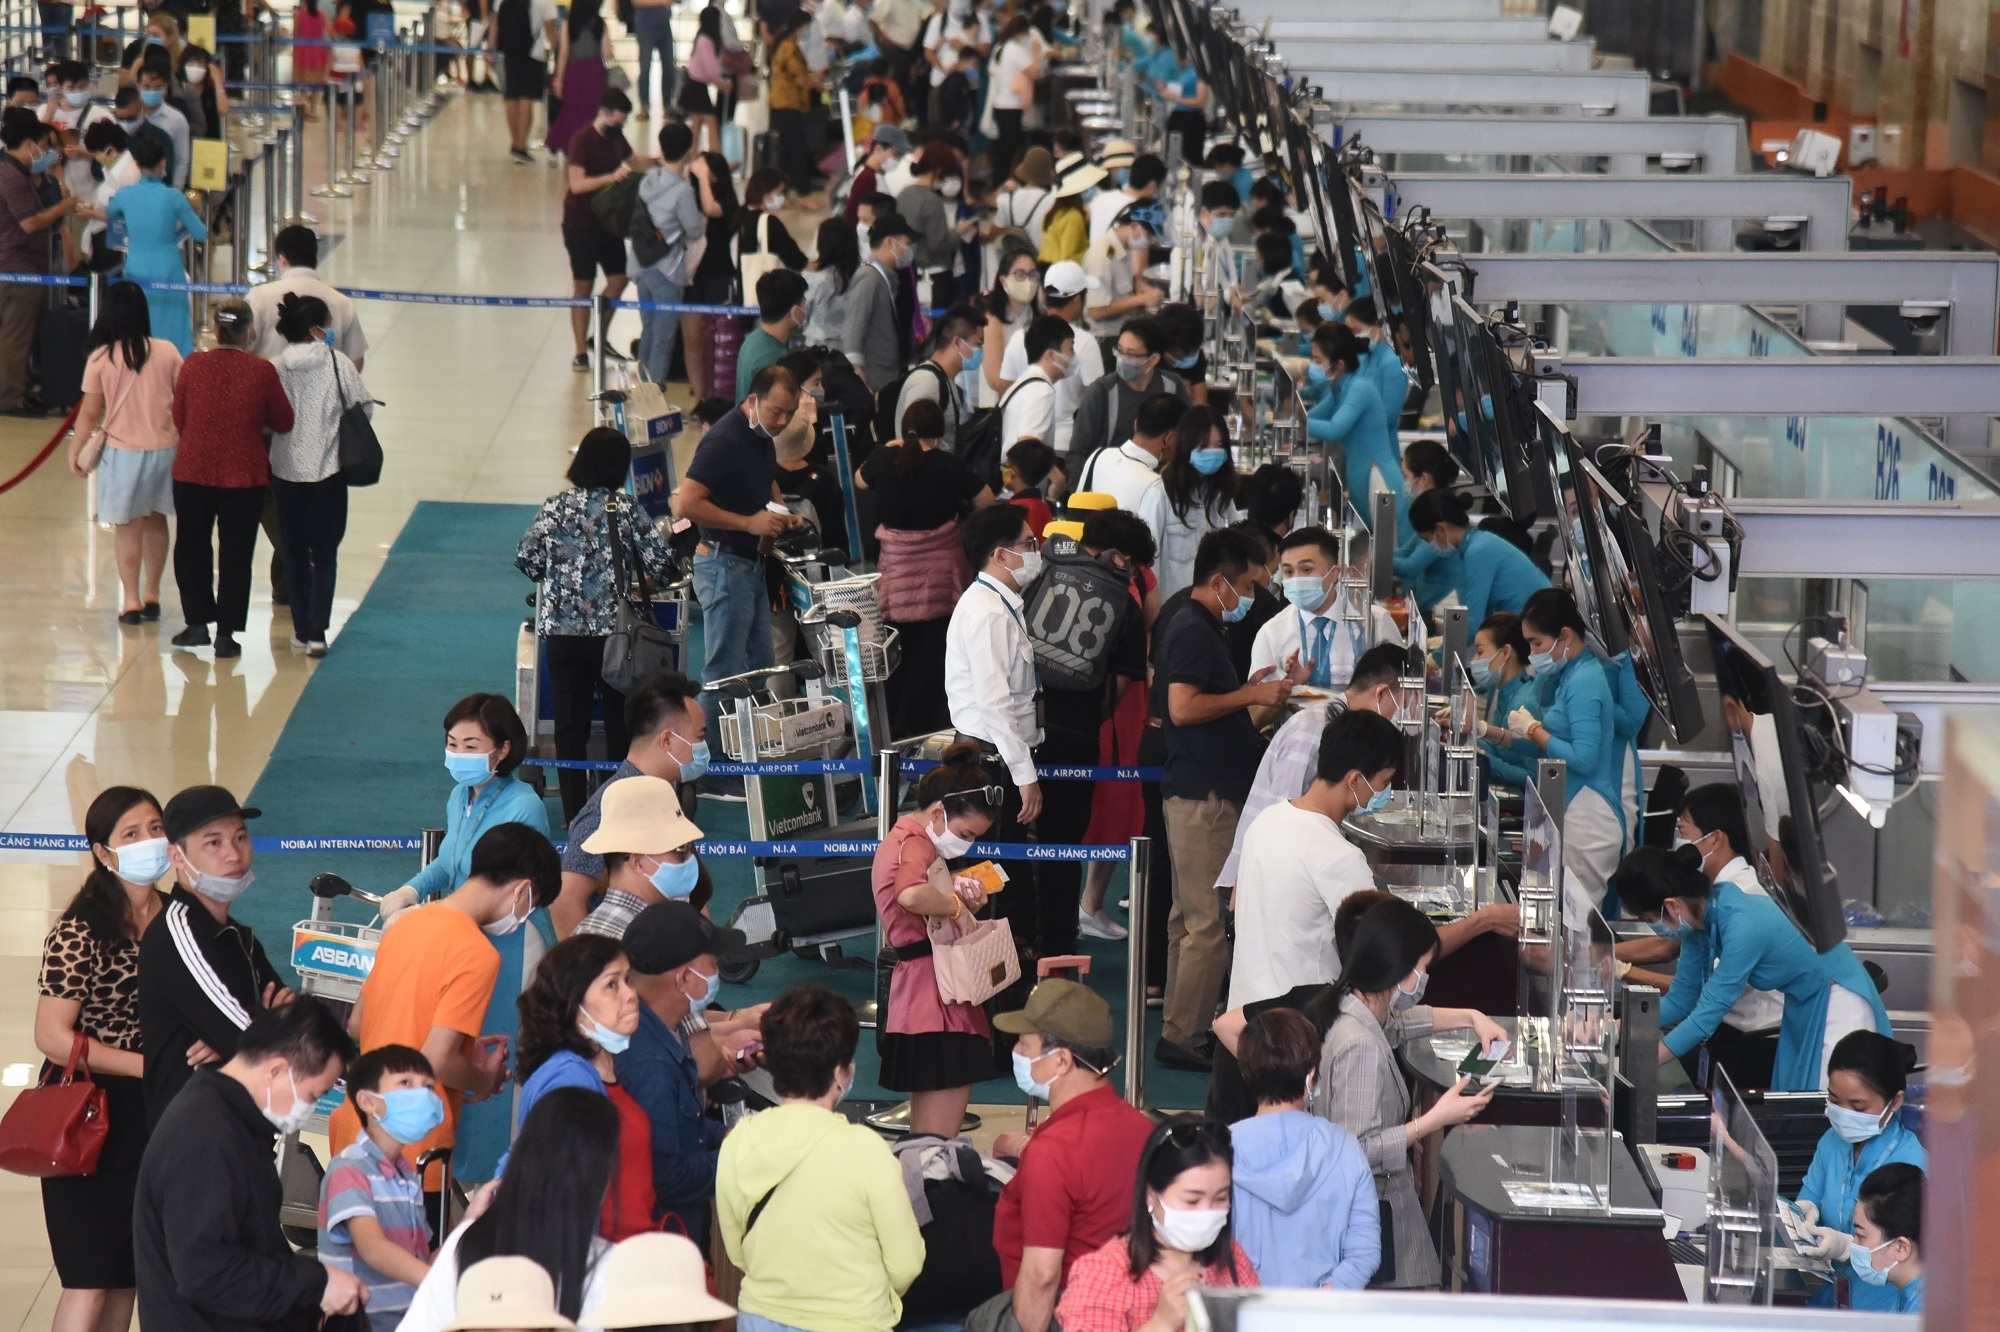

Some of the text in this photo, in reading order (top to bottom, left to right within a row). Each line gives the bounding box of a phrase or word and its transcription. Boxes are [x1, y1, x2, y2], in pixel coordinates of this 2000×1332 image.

[1876, 423, 1900, 500] B26
[1032, 583, 1115, 660] 08
[796, 720, 827, 737] Vietcombank
[706, 763, 846, 773] NATIONAL AIRPORT N.I.A
[1052, 769, 1093, 778] AIRPORT
[1117, 769, 1140, 778] N.I.A
[769, 807, 822, 836] Vietcombank
[281, 840, 317, 849] NOIBAI
[320, 840, 403, 849] INTERNATIONAL
[772, 844, 797, 853] N.I.A
[824, 843, 859, 853] NOIBAI
[977, 845, 1000, 855] N.I.A
[1090, 848, 1126, 859] KHÔNG
[311, 945, 375, 972] ABBAN
